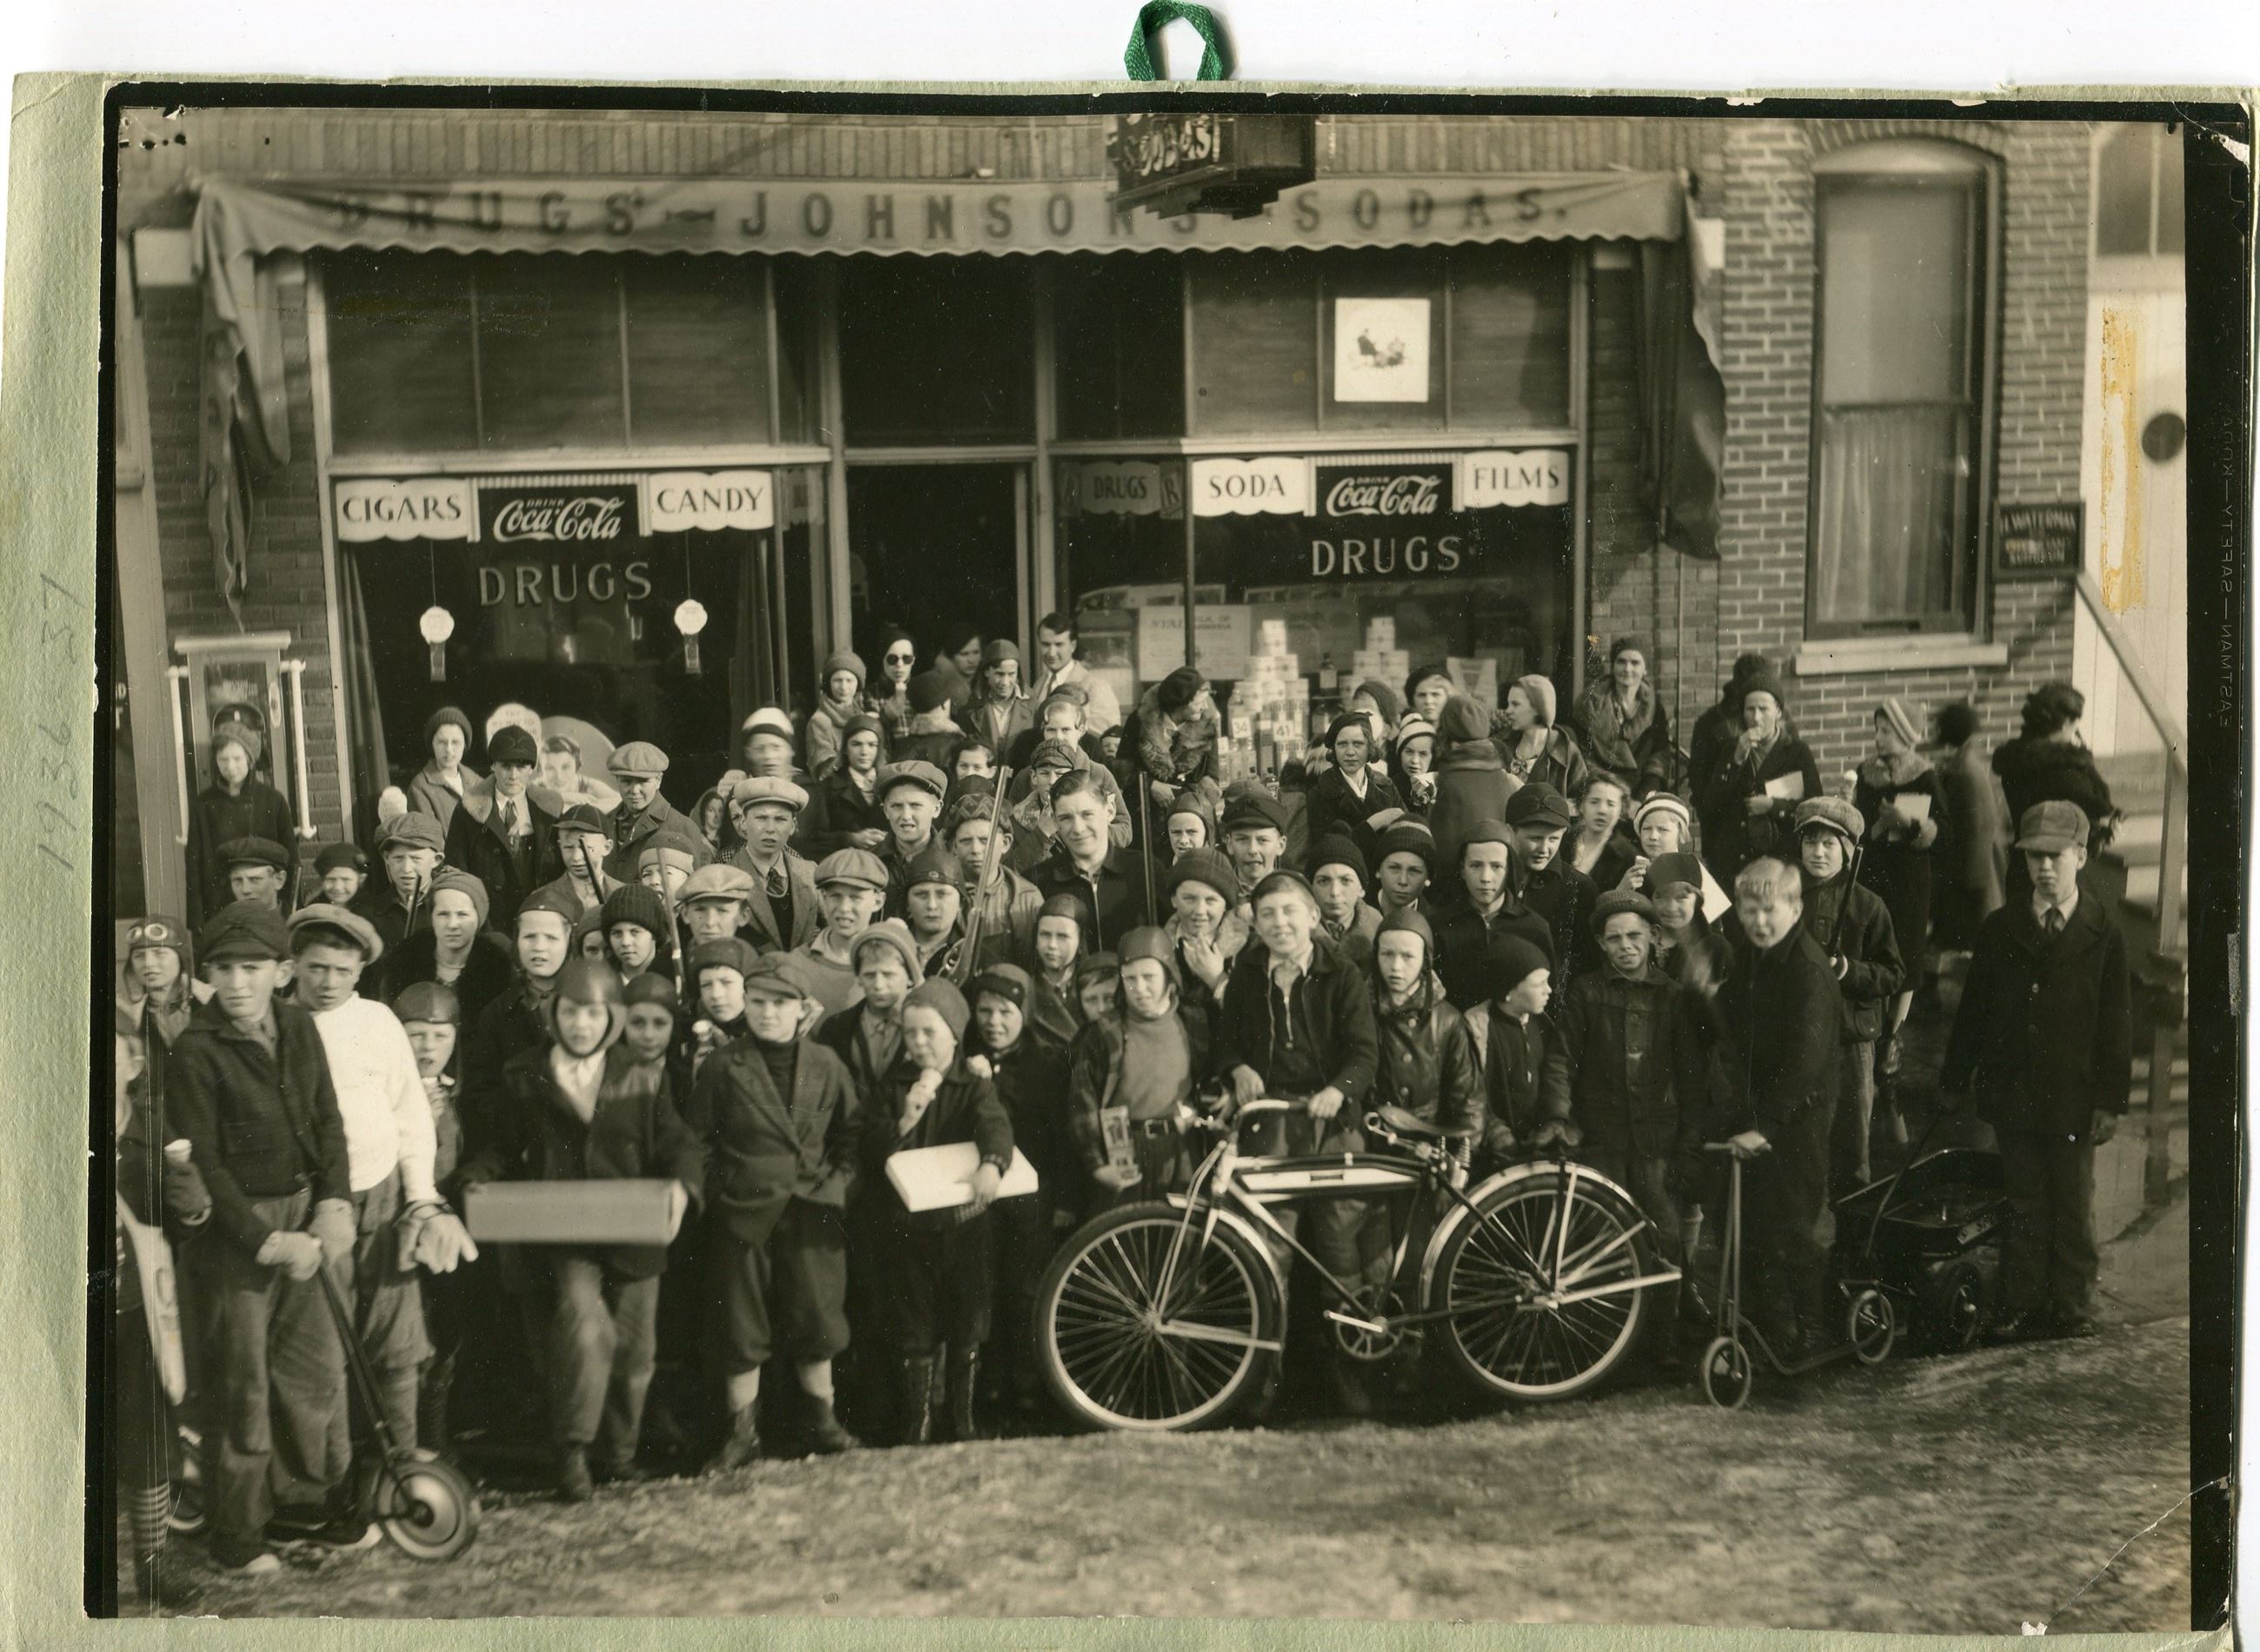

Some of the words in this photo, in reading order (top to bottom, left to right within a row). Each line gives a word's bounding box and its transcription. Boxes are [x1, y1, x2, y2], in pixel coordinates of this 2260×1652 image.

[336, 189, 635, 236] DRUGS
[1093, 474, 1148, 500] DRUGS
[1208, 473, 1286, 499] SODA
[1474, 465, 1560, 490] FILMS
[342, 494, 462, 522] CIGARS
[526, 499, 566, 508] DRINK
[656, 487, 767, 514] CANDY
[1312, 535, 1461, 576] DRUGS
[479, 561, 653, 607] DRUGS
[37, 721, 77, 871] 1936
